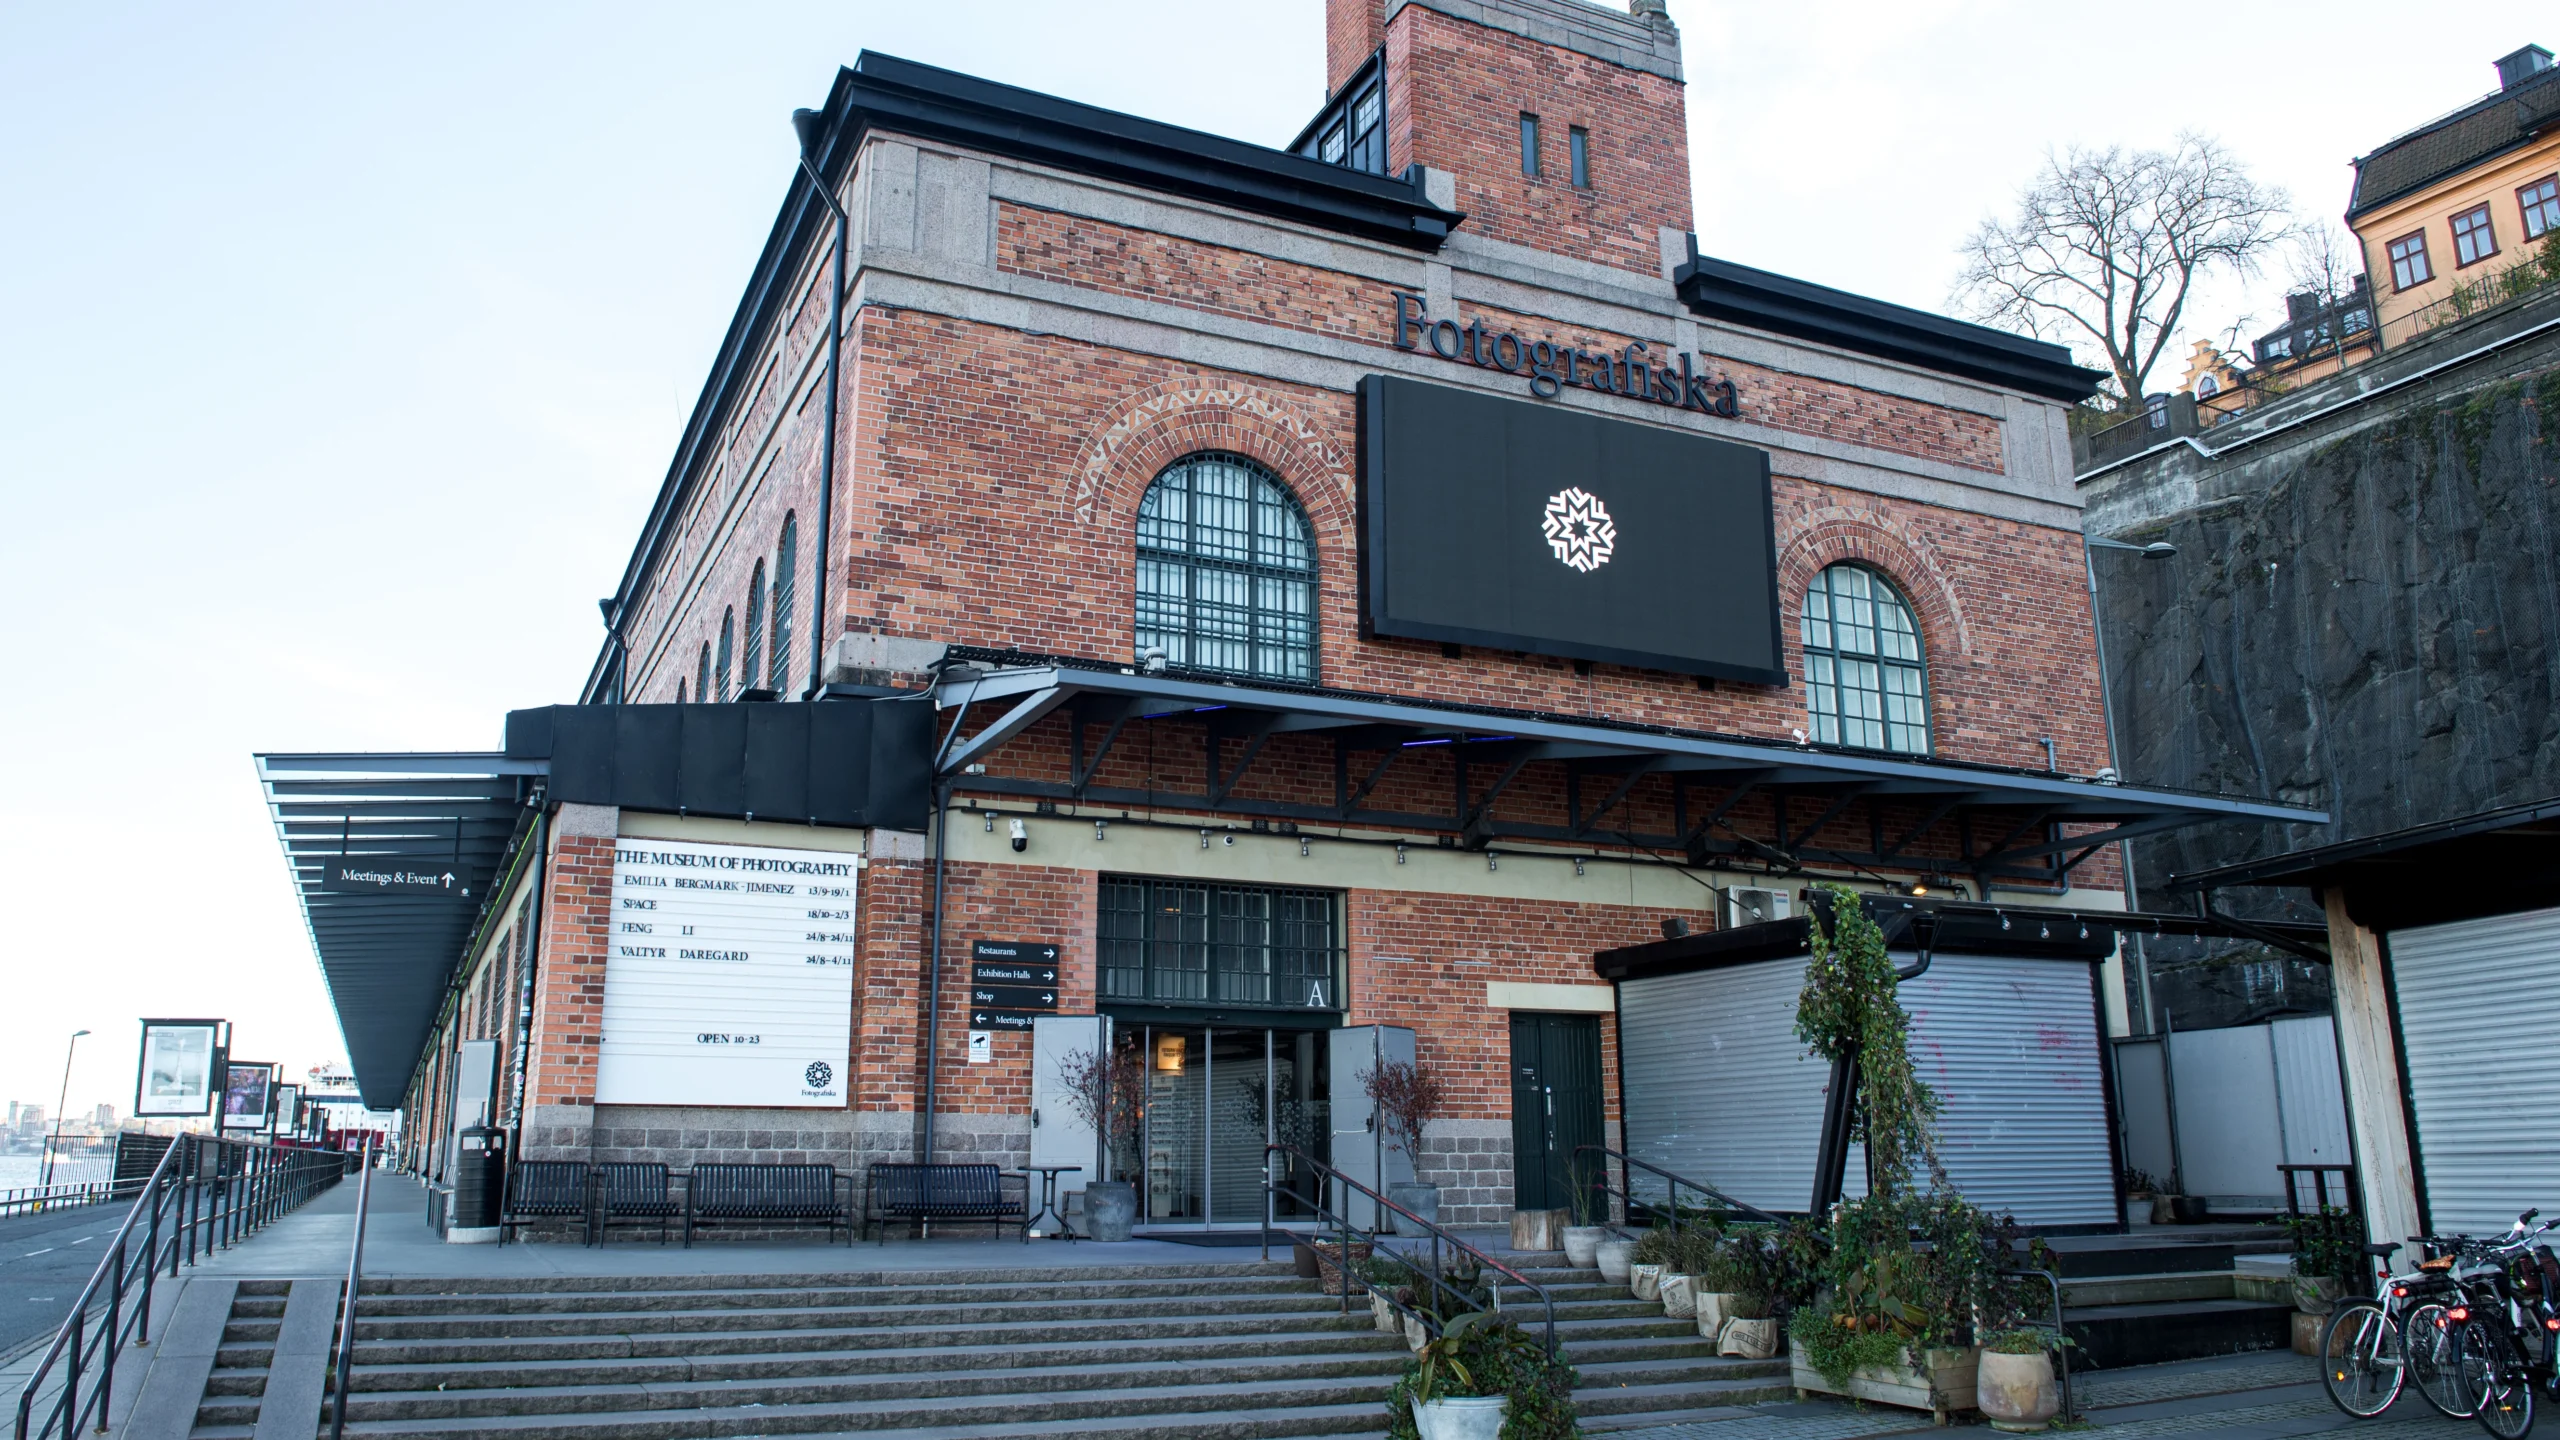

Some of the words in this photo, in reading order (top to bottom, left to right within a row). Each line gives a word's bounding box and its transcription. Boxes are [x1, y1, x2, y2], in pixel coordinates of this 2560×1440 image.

[1390, 291, 1741, 418] Fotografiska
[615, 849, 648, 864] THE
[651, 852, 716, 868] MUSEUM
[720, 856, 739, 869] OF
[742, 858, 851, 876] PHOTOGRAPHY
[341, 869, 392, 886] Meetings
[394, 872, 405, 883] &
[406, 872, 438, 885] Event
[624, 875, 667, 887] EMILIA
[808, 886, 850, 897] 13/9-19/1
[624, 898, 657, 910] SPACE
[622, 923, 652, 934] FENG
[682, 926, 694, 935] LI
[621, 947, 666, 958] VALTYR
[680, 949, 748, 961] DAREGARD
[979, 946, 1016, 956] Restaurants
[978, 969, 1011, 978] Exhibition
[1013, 971, 1030, 979] Halls
[976, 992, 993, 1002] Shop
[1307, 980, 1327, 1007] A
[996, 1016, 1025, 1026] Meetings
[697, 1033, 729, 1044] OPEN
[734, 1035, 760, 1044] 10-23
